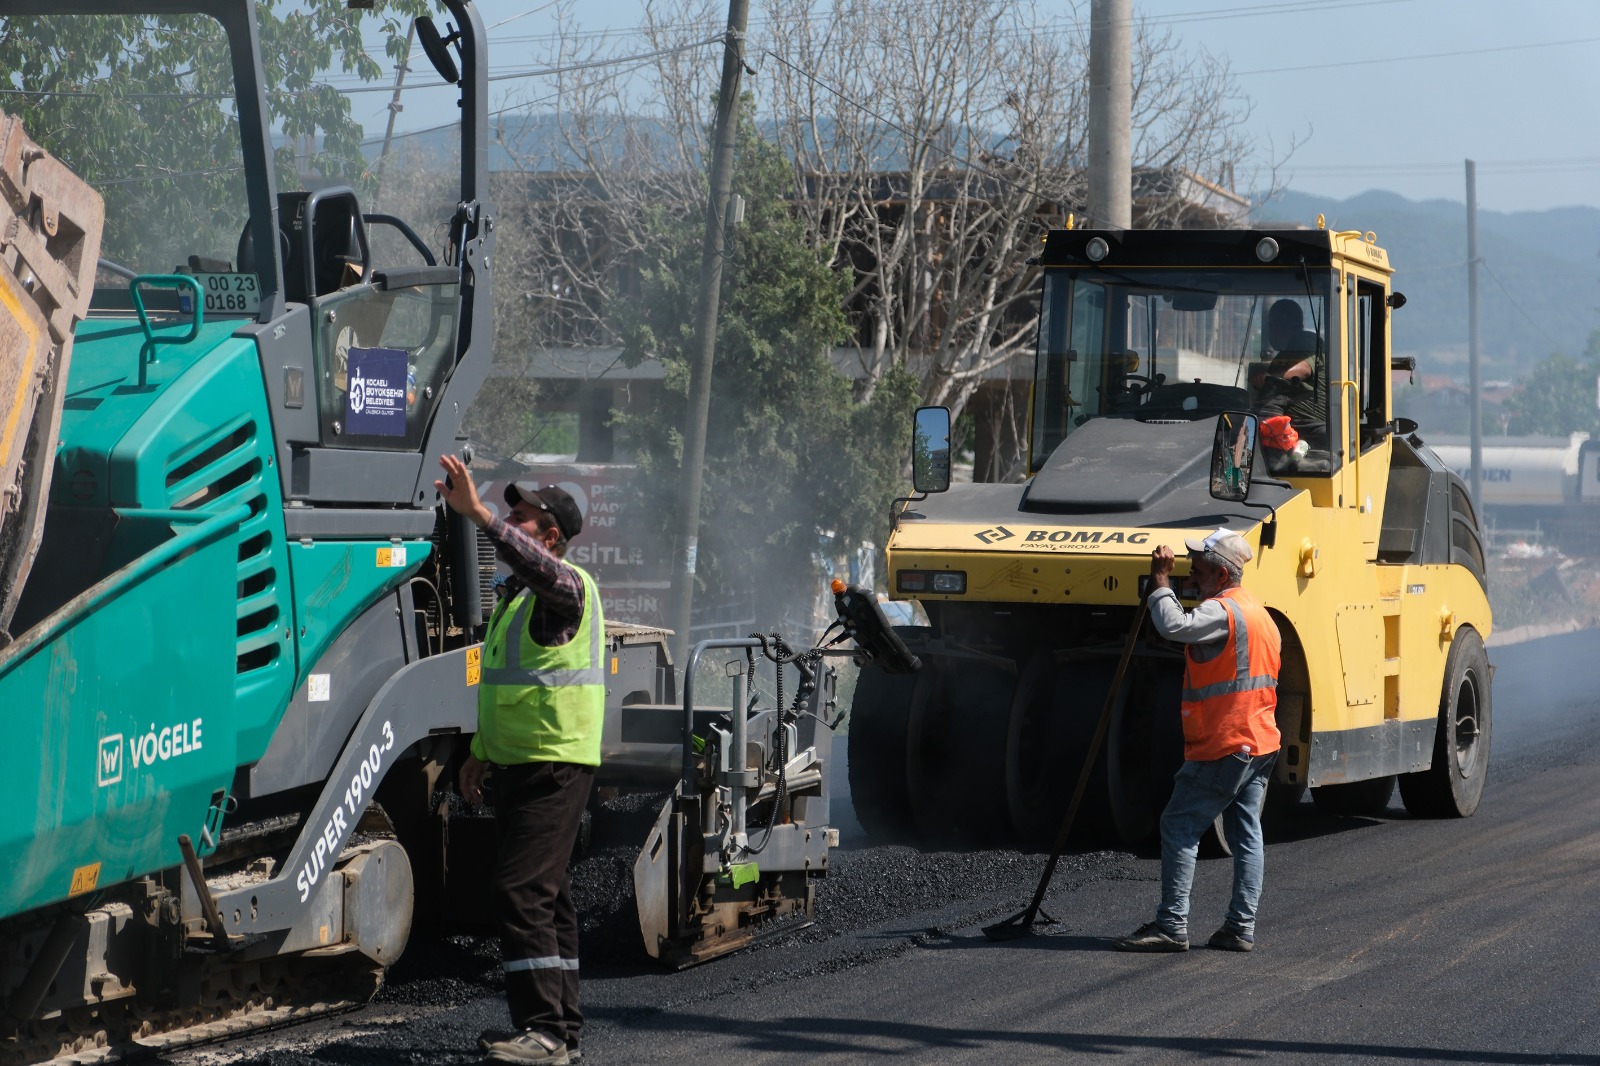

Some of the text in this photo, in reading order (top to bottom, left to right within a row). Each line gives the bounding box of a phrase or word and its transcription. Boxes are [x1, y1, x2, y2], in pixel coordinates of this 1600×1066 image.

[208, 276, 229, 291] 00
[234, 276, 255, 291] 23
[205, 294, 246, 310] 0168
[1024, 530, 1151, 544] BOMAG
[566, 542, 644, 565] KSİTLE
[296, 720, 394, 904] SUPER 1900-3
